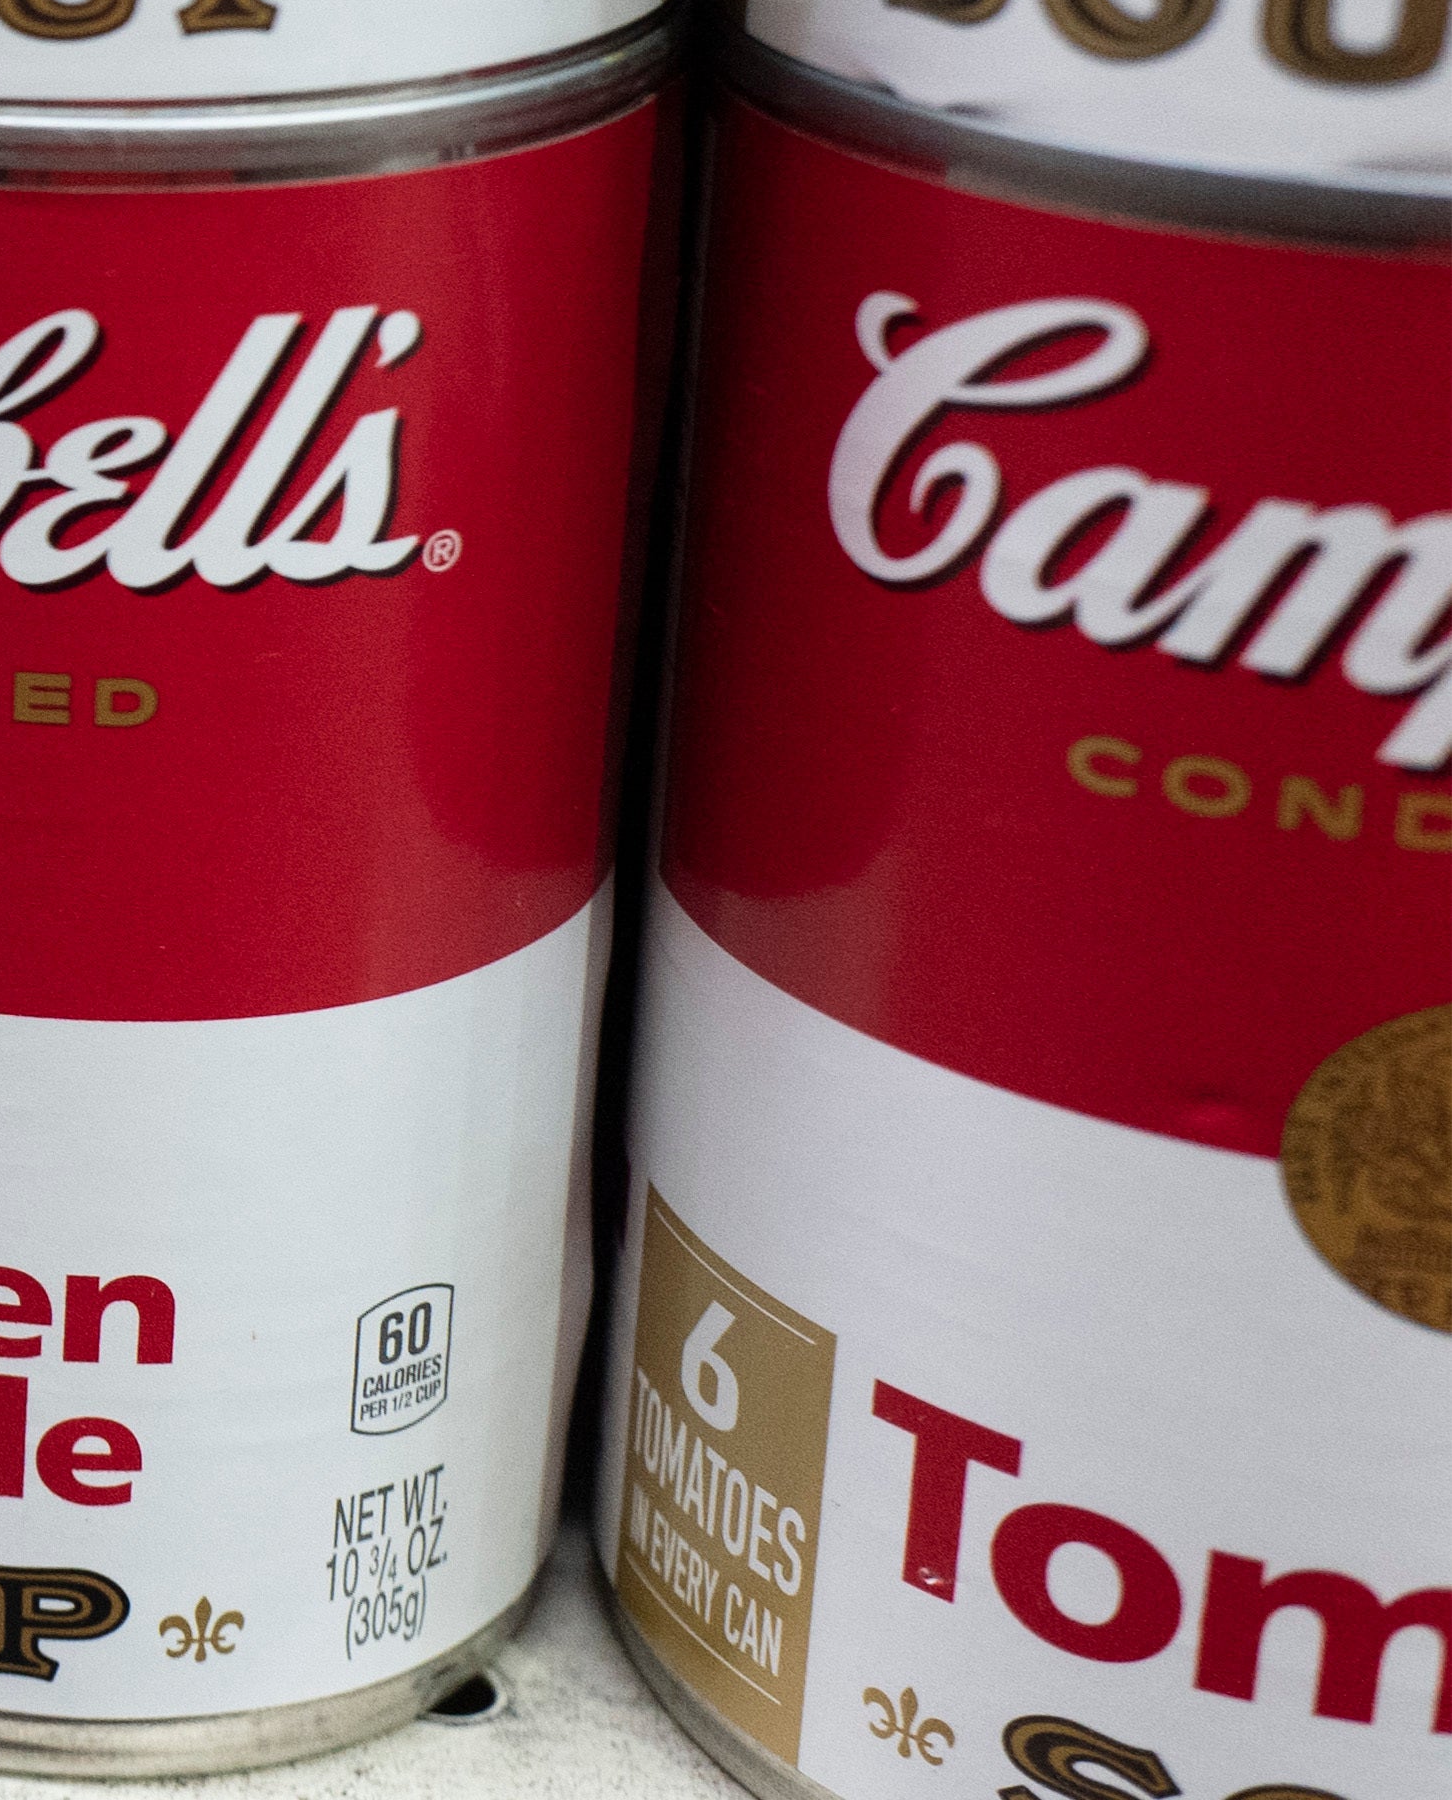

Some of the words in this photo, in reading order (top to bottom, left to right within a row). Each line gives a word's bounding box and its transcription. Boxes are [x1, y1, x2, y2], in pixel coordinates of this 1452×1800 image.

[361, 1353, 443, 1399] CALORIES
[378, 1300, 432, 1367] 60
[680, 1300, 739, 1432] 6
[359, 1393, 388, 1422] PER
[391, 1387, 413, 1413] 1/2
[414, 1377, 442, 1407] CUP
[332, 1483, 395, 1550] NET
[402, 1463, 448, 1527] WT.
[634, 1366, 807, 1597] TOMATOES
[325, 1548, 359, 1602] 10
[406, 1520, 448, 1578] OZ.
[649, 1508, 720, 1625] EVERY
[724, 1583, 783, 1677] CAN
[345, 1575, 427, 1661] (305g)
